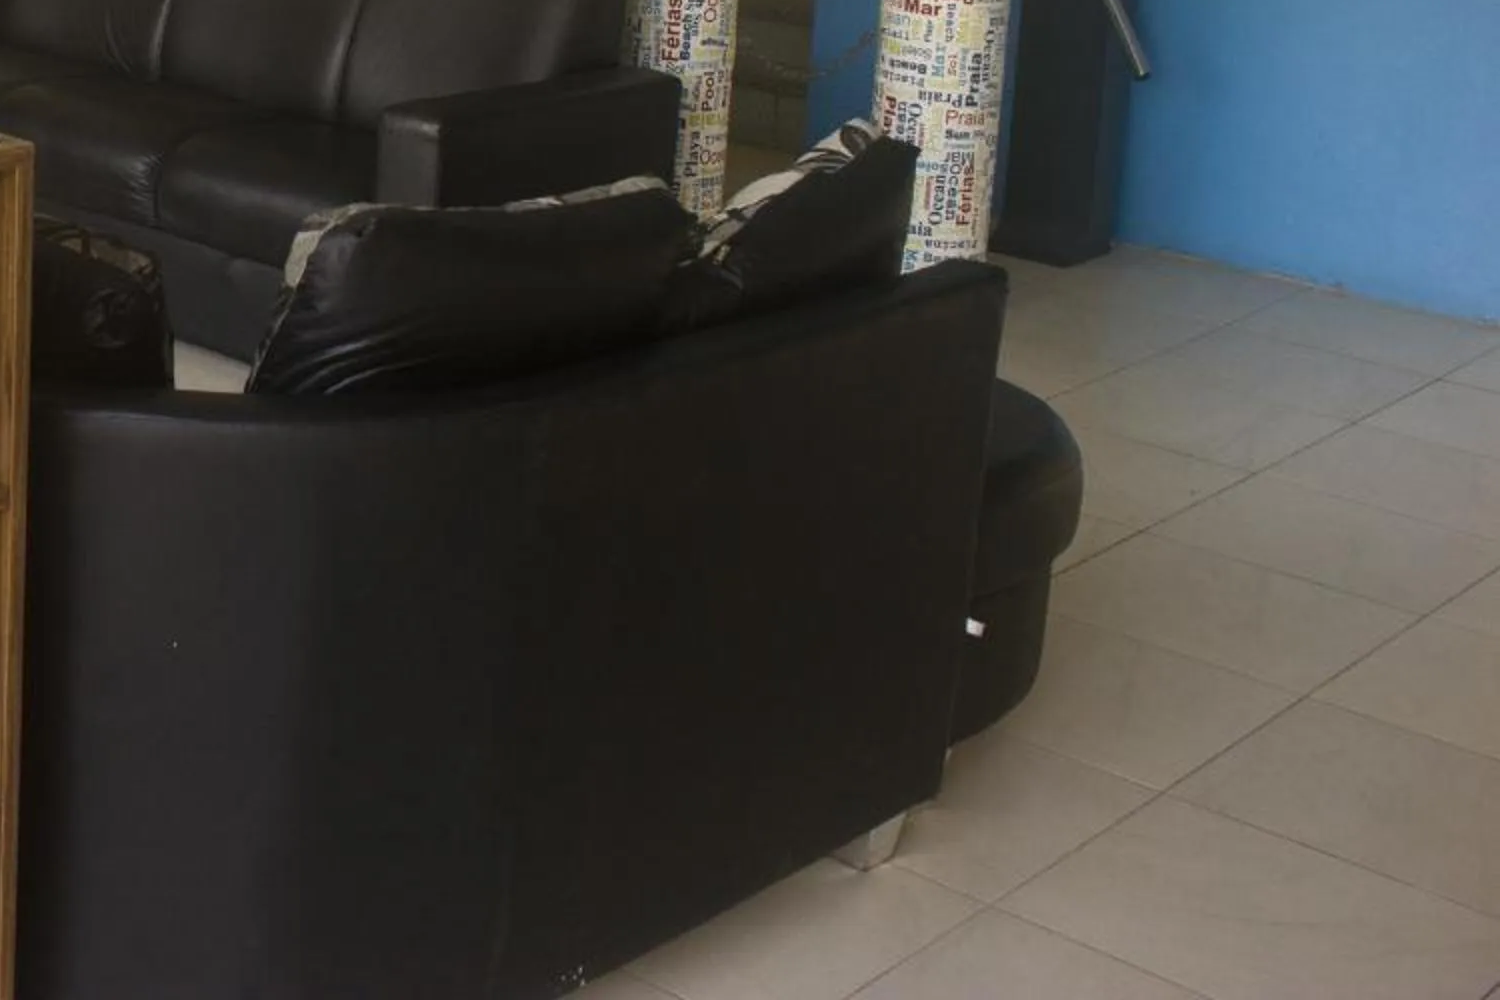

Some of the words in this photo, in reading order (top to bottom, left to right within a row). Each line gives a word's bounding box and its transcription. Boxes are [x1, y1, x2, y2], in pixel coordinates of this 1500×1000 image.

[680, 13, 692, 60] Beach
[932, 43, 946, 77] Mar
[701, 71, 715, 112] Pool
[919, 90, 962, 109] Praia
[965, 53, 982, 107] Praia
[945, 129, 971, 140] Sun
[946, 109, 985, 125] Praia
[684, 131, 700, 178] Playa
[928, 175, 946, 225] Ocean
[945, 163, 961, 221] Ocean
[955, 163, 975, 226] Férias
